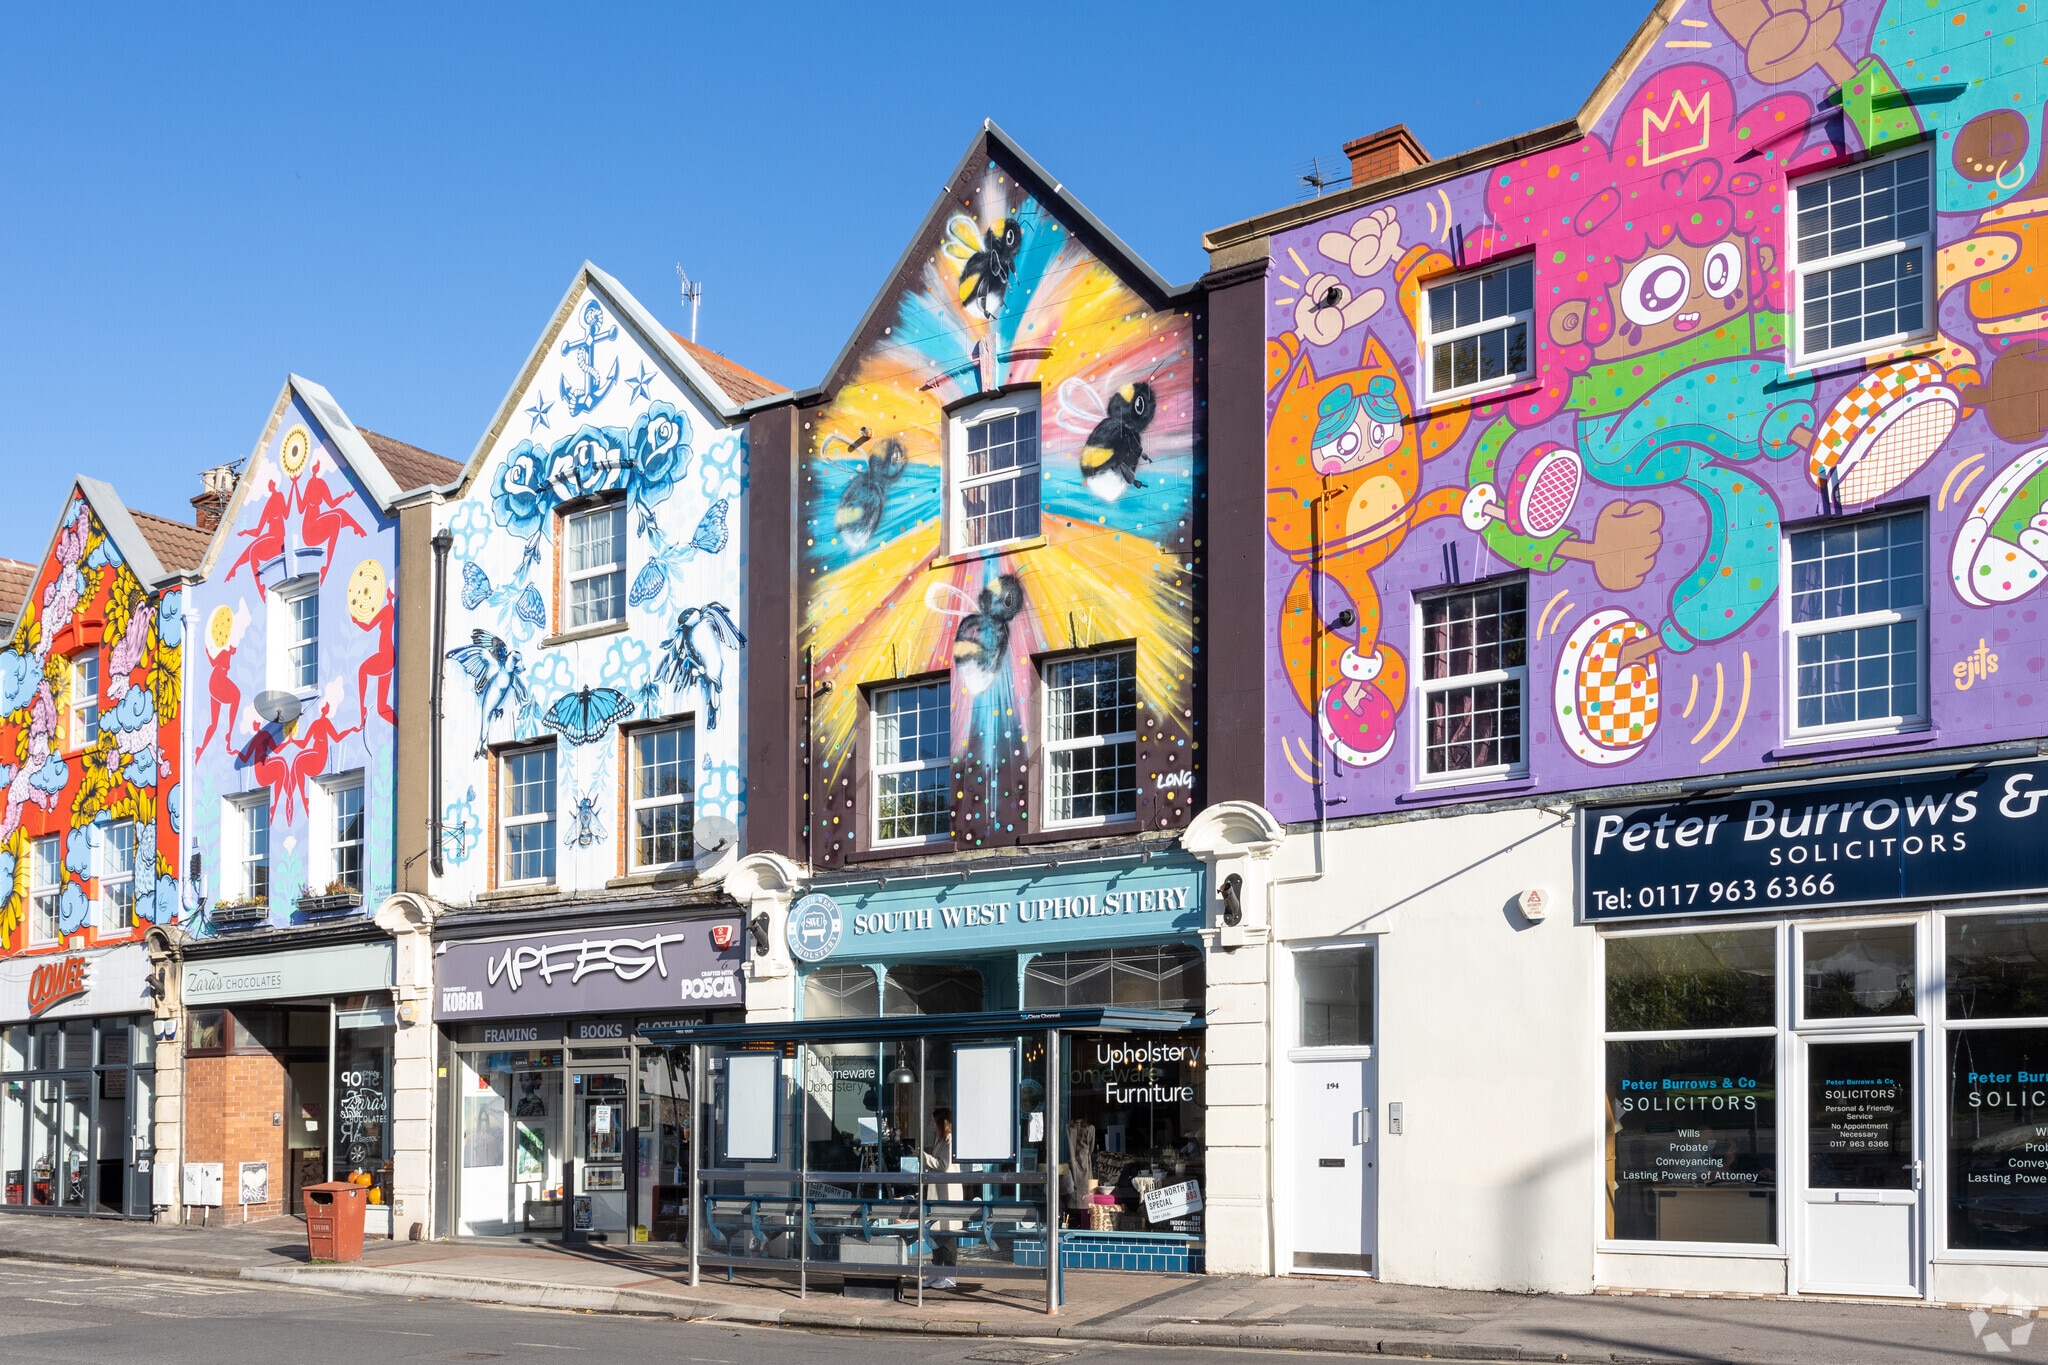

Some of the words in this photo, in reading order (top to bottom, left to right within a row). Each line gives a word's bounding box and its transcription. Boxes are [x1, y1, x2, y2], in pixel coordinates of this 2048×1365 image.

[1953, 638, 1998, 691] ejits
[1157, 769, 1192, 789] LONG
[1593, 812, 1729, 855] Peter
[1743, 790, 1979, 842] Burrows
[1999, 773, 2048, 819] &
[1769, 831, 1967, 866] SOLICITORS
[1592, 887, 1632, 911] Tel:
[1638, 883, 1700, 908] 0117
[1708, 879, 1757, 903] 963
[1766, 872, 1835, 899] 6366
[794, 896, 816, 915] SOUTH
[818, 896, 835, 912] WEST
[854, 907, 934, 936] SOUTH
[939, 902, 1011, 930] WEST
[1016, 886, 1191, 924] UPHOLSTERY
[805, 917, 823, 928] SWU
[791, 934, 837, 959] UPHOLSTERY
[487, 933, 685, 991] UPFEST
[28, 956, 86, 1006] OOWEE
[187, 970, 223, 992] Zara's
[225, 975, 281, 990] CHOCOLATES
[681, 976, 737, 1000] POSCA
[442, 991, 484, 1012] KOBRA
[484, 1027, 538, 1042] FRAMING
[580, 1023, 623, 1039] BOOKS
[1096, 1040, 1200, 1071] Upholstery
[1070, 1066, 1160, 1084] omeware
[1968, 1072, 2012, 1084] Peter
[1326, 1082, 1339, 1090] 194
[1622, 1079, 1658, 1090] Peter
[1662, 1078, 1717, 1090] Burrows
[1722, 1077, 1733, 1089] &
[1738, 1077, 1756, 1089] Co
[1105, 1081, 1194, 1104] Furniture
[1825, 1089, 1895, 1099] SOLICITORS
[1968, 1091, 2046, 1107] SOLIC
[1623, 1096, 1757, 1111] SOLICITORS
[1677, 1129, 1700, 1138] Wills
[1669, 1143, 1708, 1152] Probate
[137, 1159, 150, 1173] 202
[1655, 1157, 1724, 1167] Conveyancing
[1623, 1171, 1658, 1181] Lasting
[1661, 1171, 1697, 1180] Powers
[1701, 1171, 1711, 1180] of
[1714, 1171, 1759, 1182] Attorney
[1968, 1173, 2011, 1185] Lasting
[2015, 1173, 2047, 1183] Powe
[824, 1185, 841, 1196] NORTH
[1147, 1191, 1162, 1201] KEEP
[1164, 1184, 1185, 1196] NORTH
[1187, 1182, 1195, 1190] ST
[1186, 1191, 1198, 1200] BS3
[1149, 1198, 1173, 1211] SPECIAL
